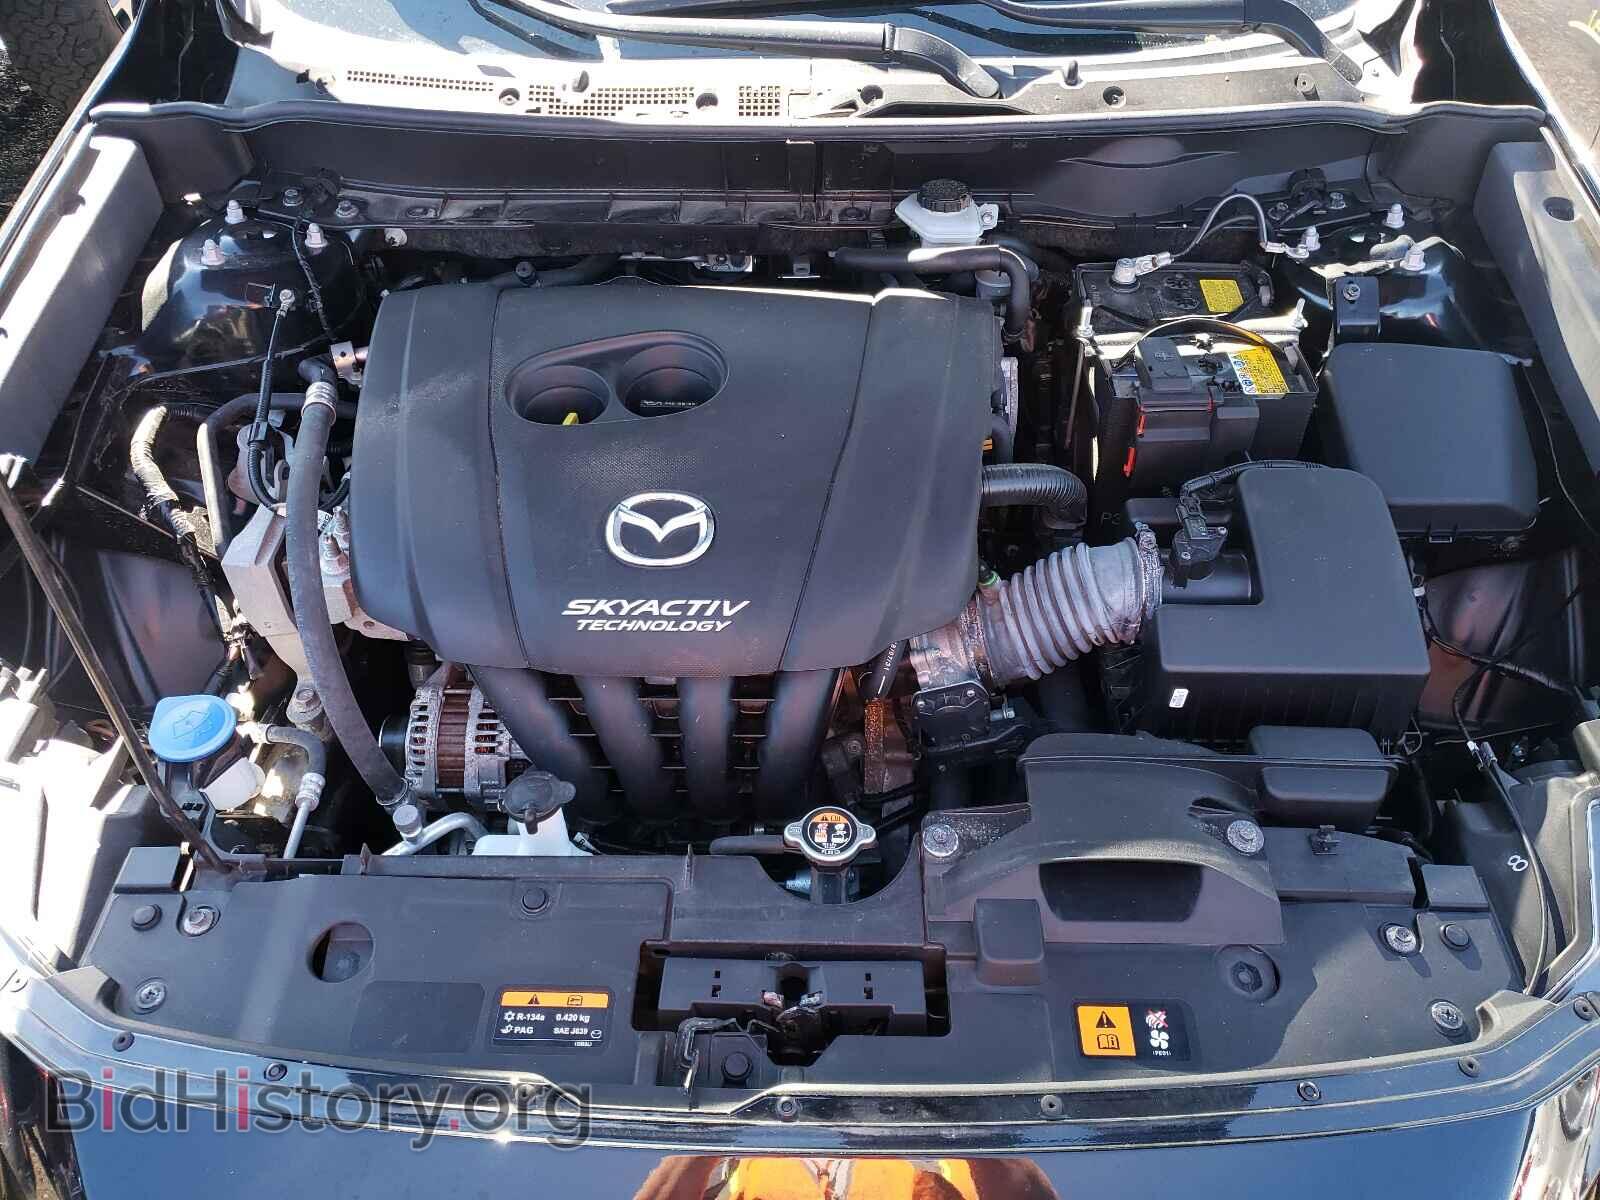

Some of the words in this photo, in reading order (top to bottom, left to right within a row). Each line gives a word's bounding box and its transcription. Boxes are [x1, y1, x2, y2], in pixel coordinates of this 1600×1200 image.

[561, 599, 750, 617] SKYACTIV
[576, 619, 732, 632] TECHNOLOGY
[516, 1012, 545, 1021] R-134a
[555, 1013, 578, 1022] 0.420
[579, 1014, 590, 1024] kg
[514, 1026, 534, 1034] PAG
[553, 1027, 570, 1035] SAE
